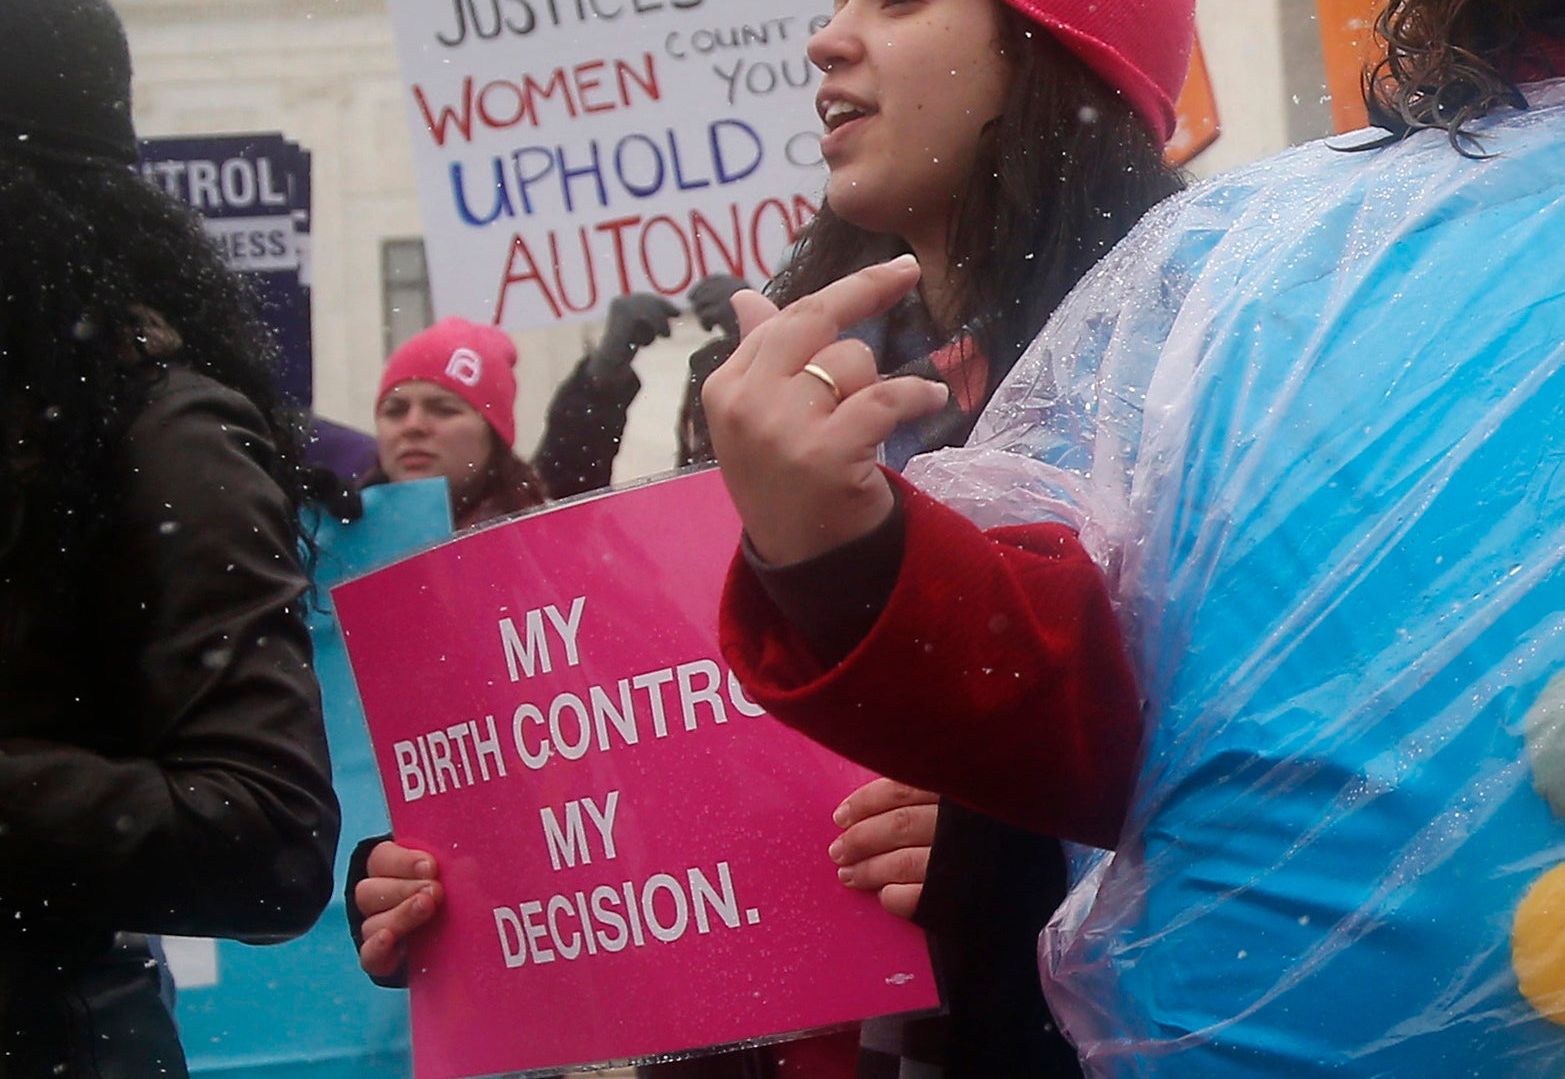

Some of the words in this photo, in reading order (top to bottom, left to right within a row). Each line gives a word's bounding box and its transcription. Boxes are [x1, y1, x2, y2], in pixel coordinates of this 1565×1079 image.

[665, 16, 794, 58] COUNT
[713, 55, 811, 105] YOU
[412, 52, 660, 146] WOMEN
[449, 118, 764, 226] UPHOLD
[499, 596, 587, 682] MY
[393, 716, 507, 802] BIRTH
[540, 791, 621, 870] MY
[493, 861, 761, 969] DECISION.
